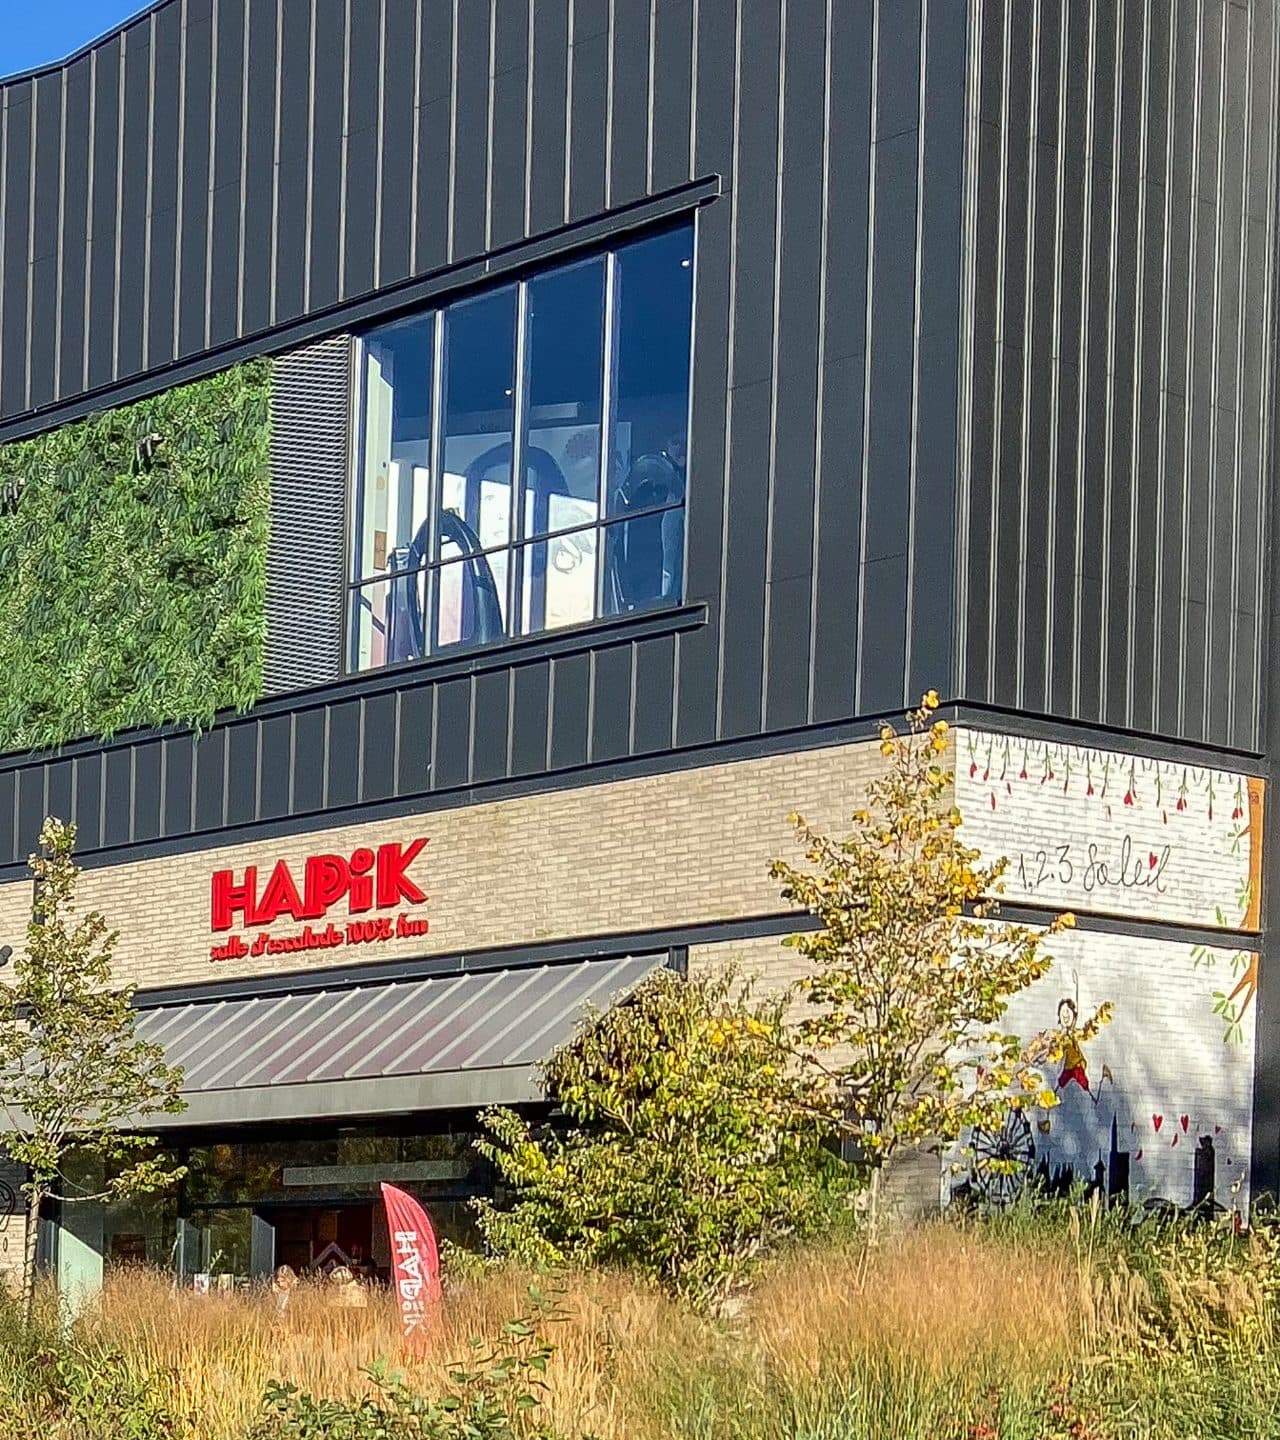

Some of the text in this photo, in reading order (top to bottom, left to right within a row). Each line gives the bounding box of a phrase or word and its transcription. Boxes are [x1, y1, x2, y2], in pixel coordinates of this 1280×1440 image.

[210, 913, 430, 962] salle d'escalade 100% fun
